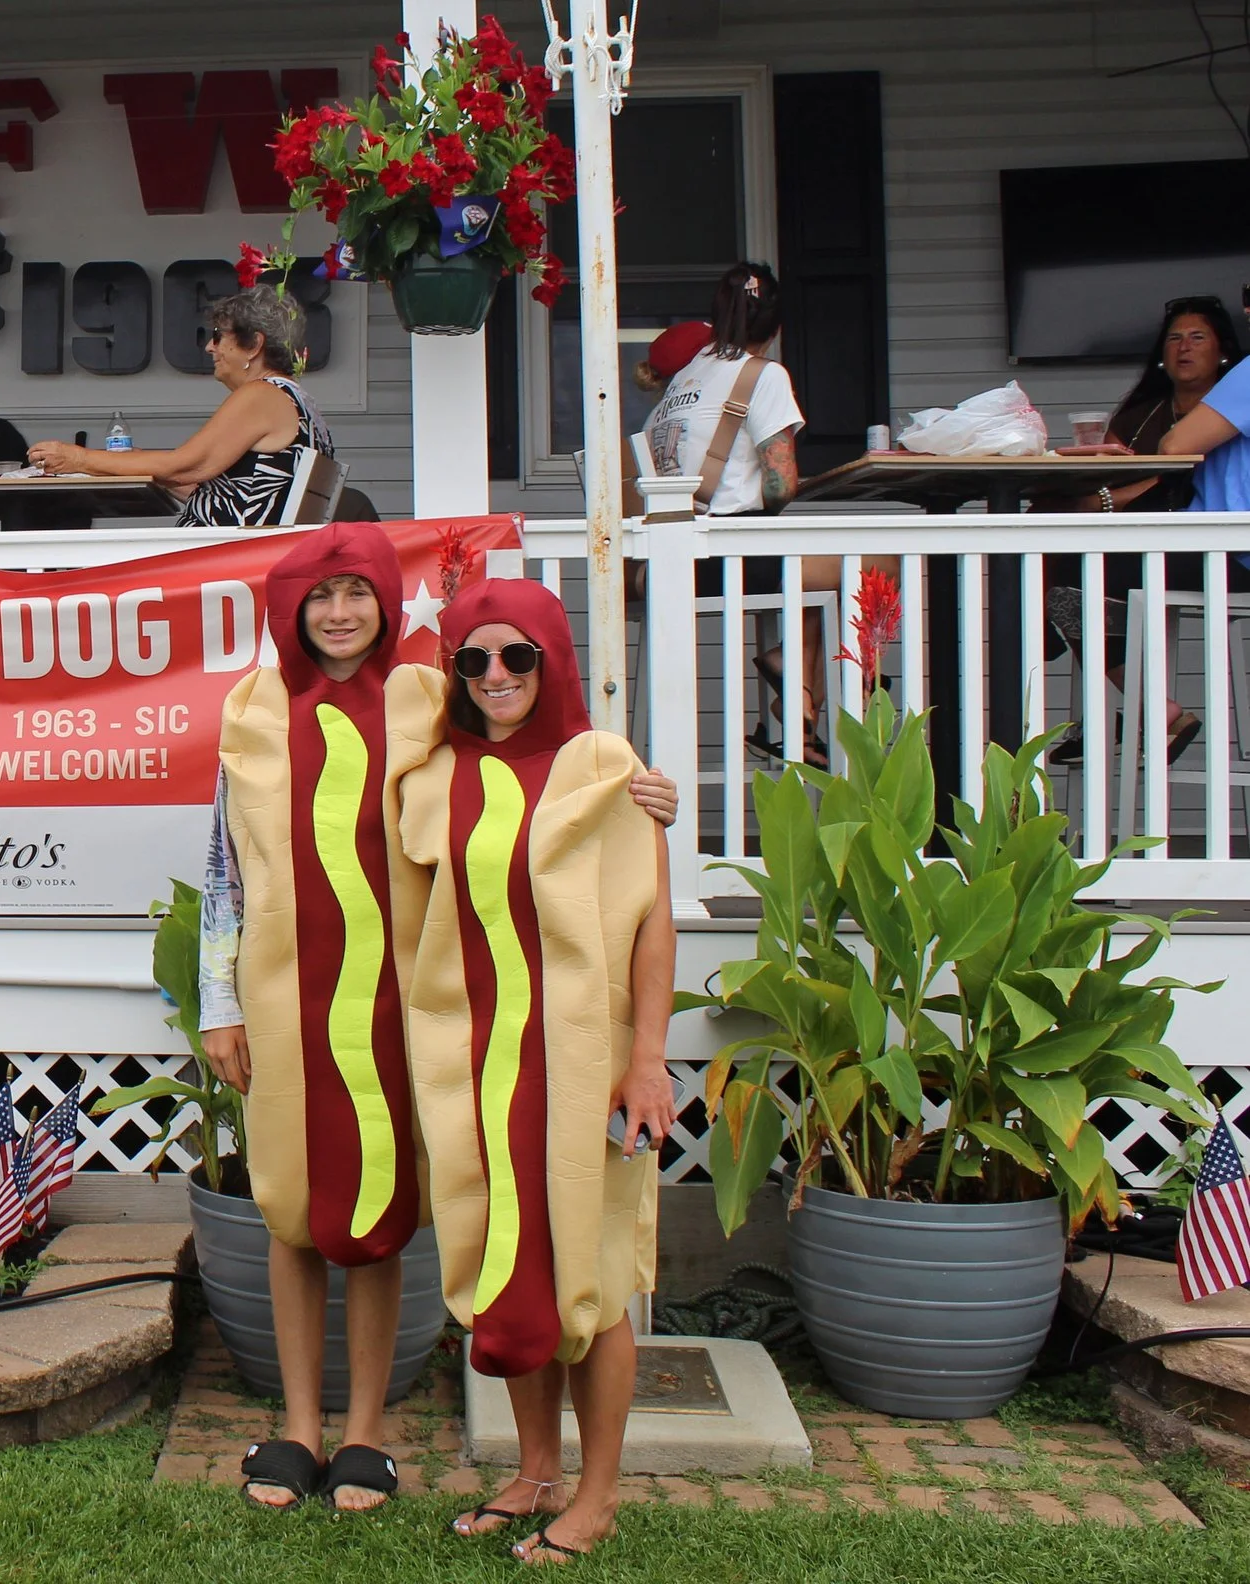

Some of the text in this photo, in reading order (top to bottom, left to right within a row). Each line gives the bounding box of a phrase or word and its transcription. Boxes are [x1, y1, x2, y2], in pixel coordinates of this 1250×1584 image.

[0, 587, 171, 679] DOG
[12, 708, 97, 738] 1963
[134, 705, 190, 736] SIC
[36, 878, 76, 887] VODKA
